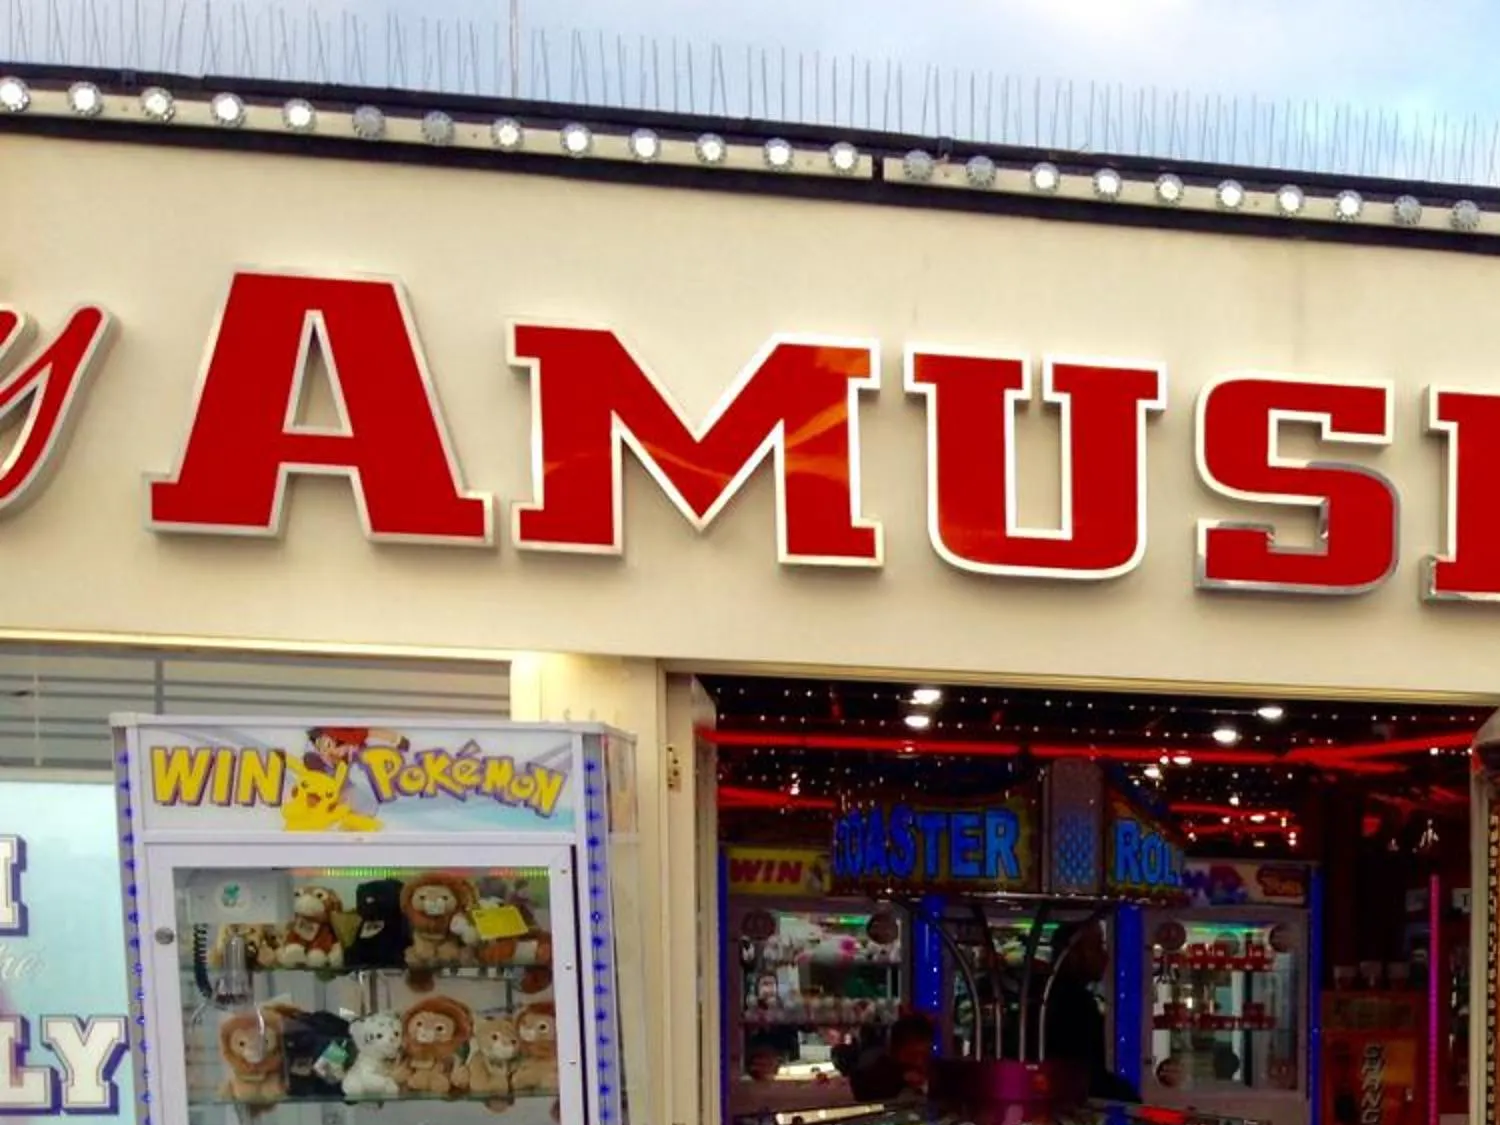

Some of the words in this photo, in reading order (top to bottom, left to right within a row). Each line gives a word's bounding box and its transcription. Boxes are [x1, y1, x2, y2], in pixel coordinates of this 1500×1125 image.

[149, 746, 286, 807] WIN
[730, 857, 804, 885] WIN
[834, 803, 1022, 879] COASTER
